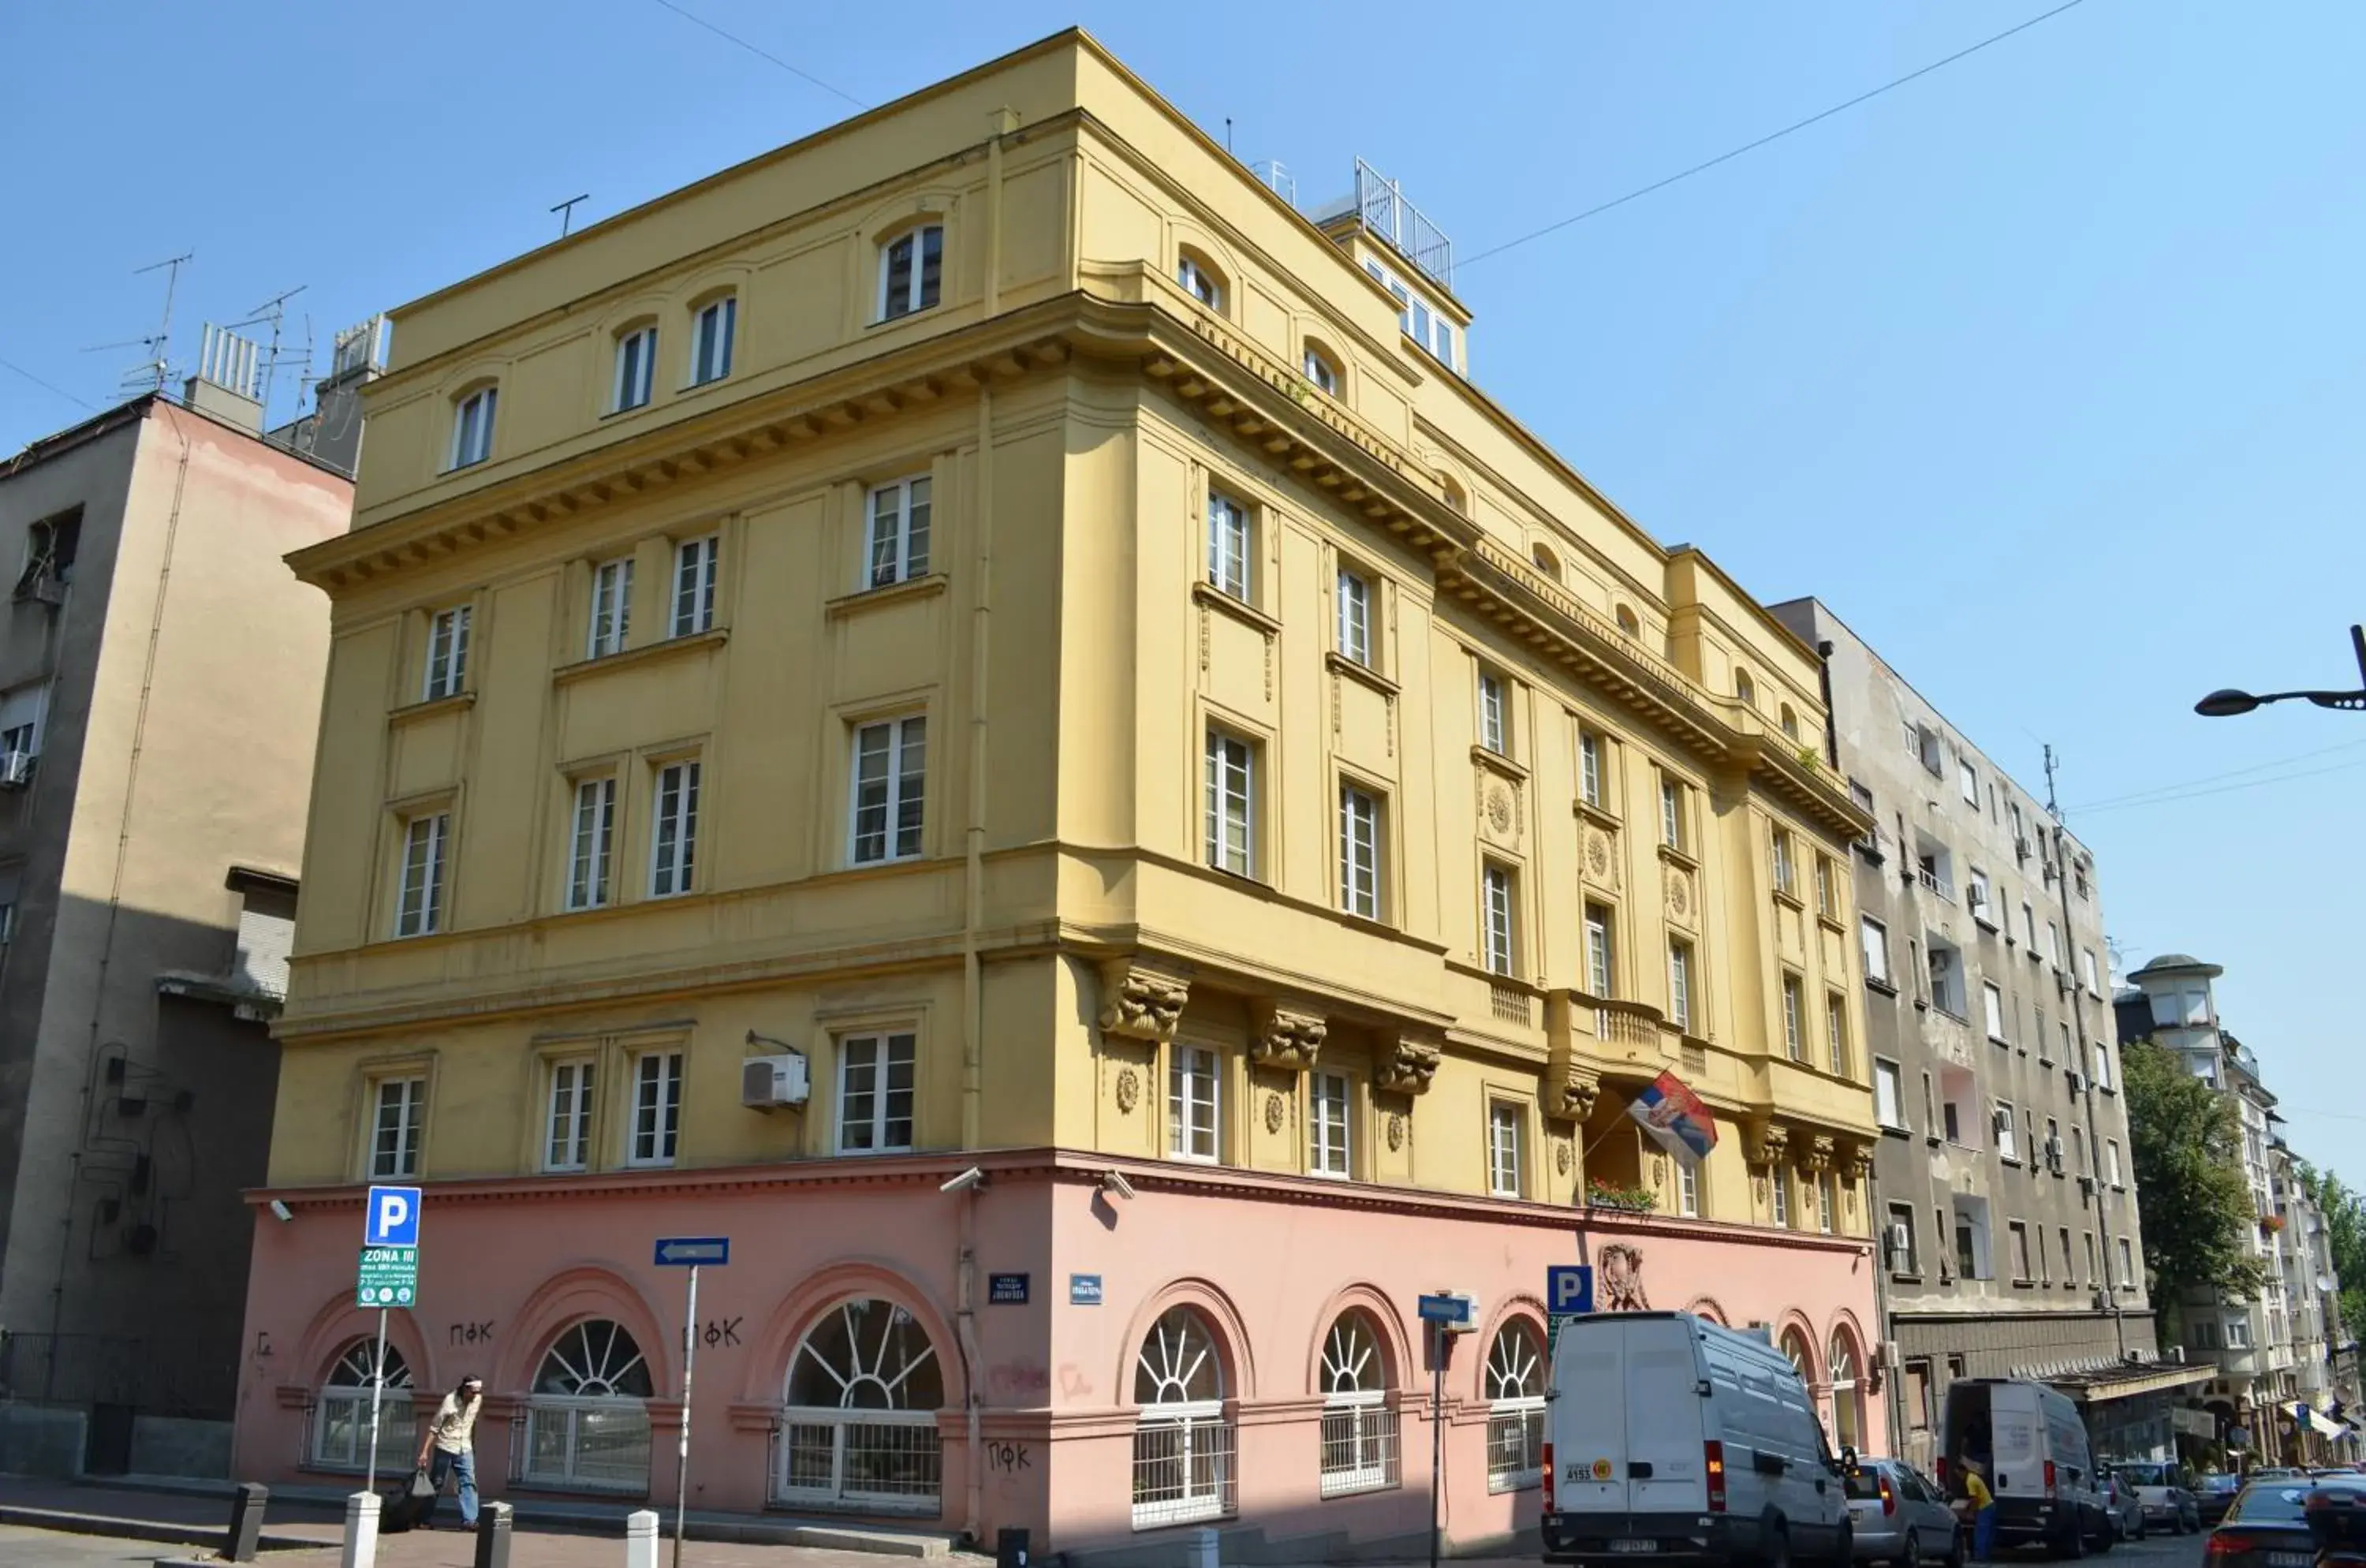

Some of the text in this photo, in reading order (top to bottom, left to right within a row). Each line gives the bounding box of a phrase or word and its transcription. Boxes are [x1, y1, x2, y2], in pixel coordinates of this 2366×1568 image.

[379, 1195, 407, 1238] P
[364, 1249, 399, 1262] ZONA
[1558, 1272, 1581, 1306] P
